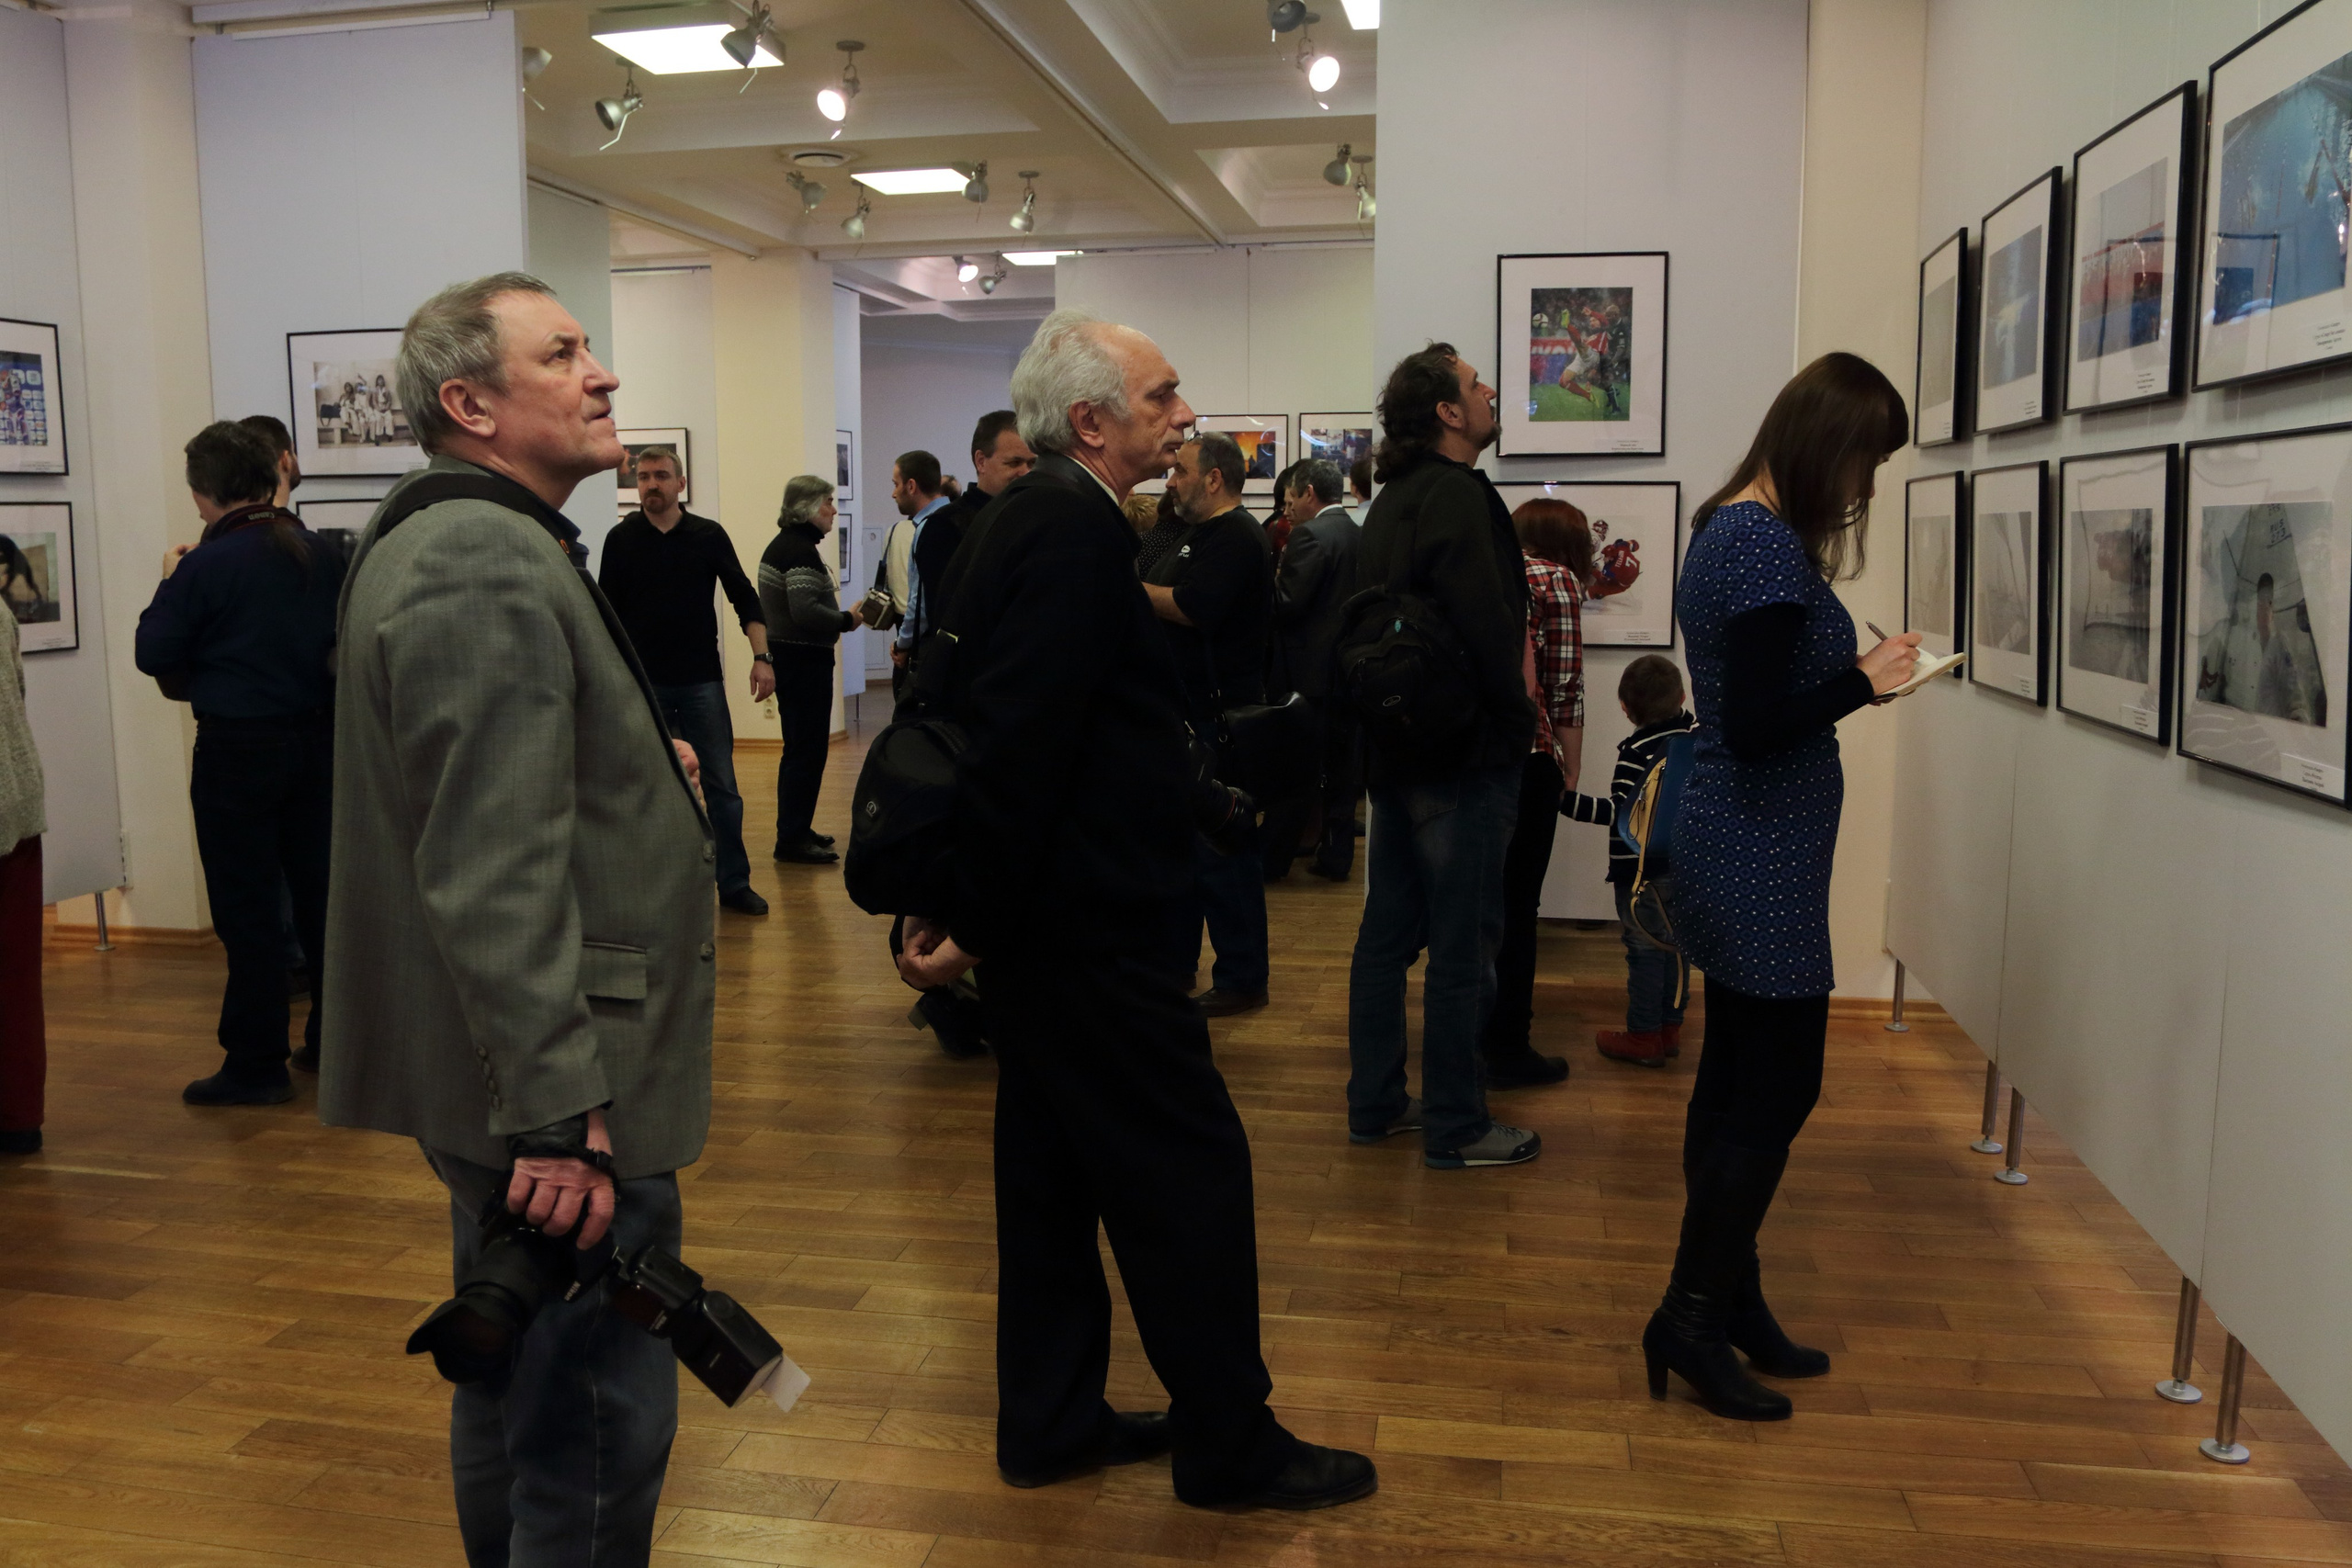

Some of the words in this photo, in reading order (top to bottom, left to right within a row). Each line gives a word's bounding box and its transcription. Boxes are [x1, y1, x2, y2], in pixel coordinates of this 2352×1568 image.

[248, 512, 275, 520] Canon
[1625, 556, 1637, 568] 7
[564, 1280, 581, 1301] Nikon
